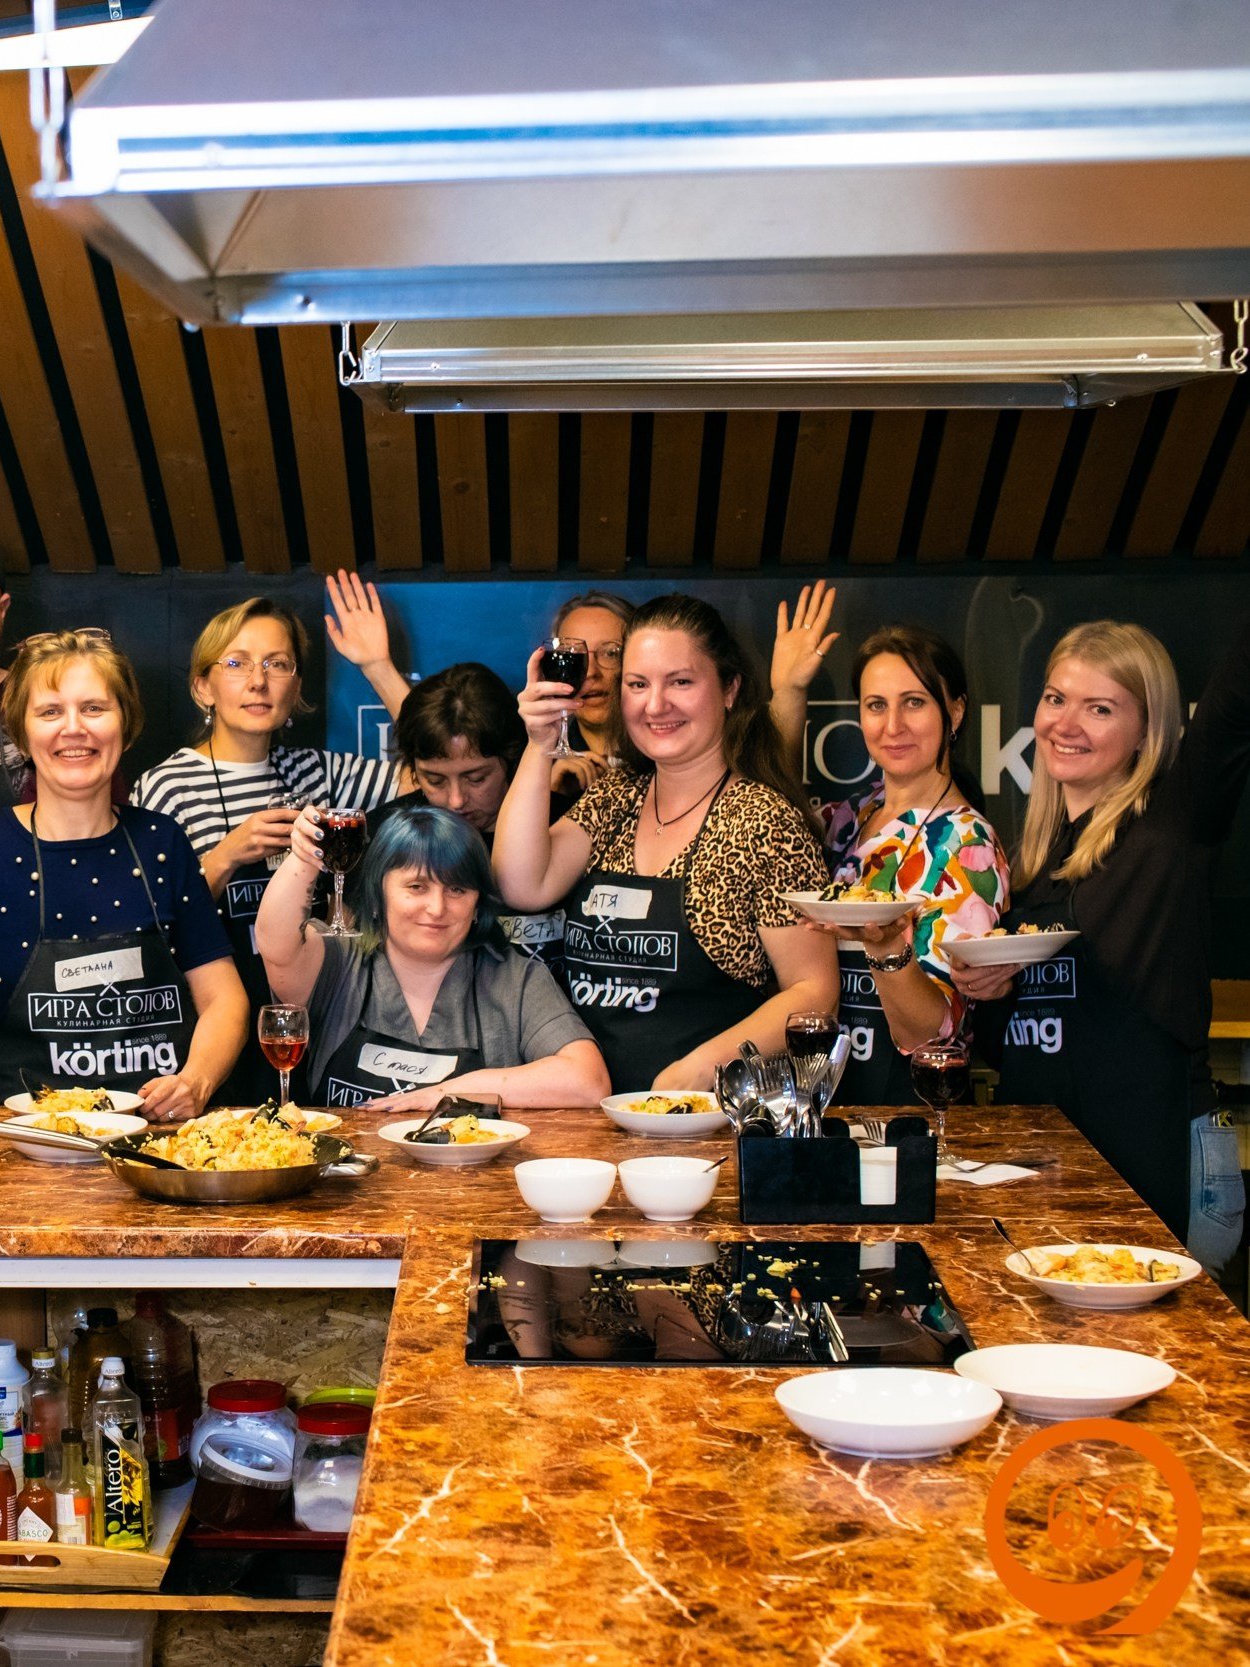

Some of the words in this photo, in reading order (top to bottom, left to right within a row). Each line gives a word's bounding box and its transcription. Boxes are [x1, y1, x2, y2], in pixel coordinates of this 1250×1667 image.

[232, 883, 264, 904] ИГР
[591, 893, 618, 908] АТЯ
[34, 998, 91, 1018] ИГРА
[96, 990, 175, 1017] СТОЛОВ
[56, 1018, 121, 1028] КУЛИНАРНАЯ
[151, 1033, 168, 1042] 1889
[49, 1039, 179, 1077] körting
[105, 1449, 124, 1514] Altero
[18, 1529, 48, 1538] ABASCO
